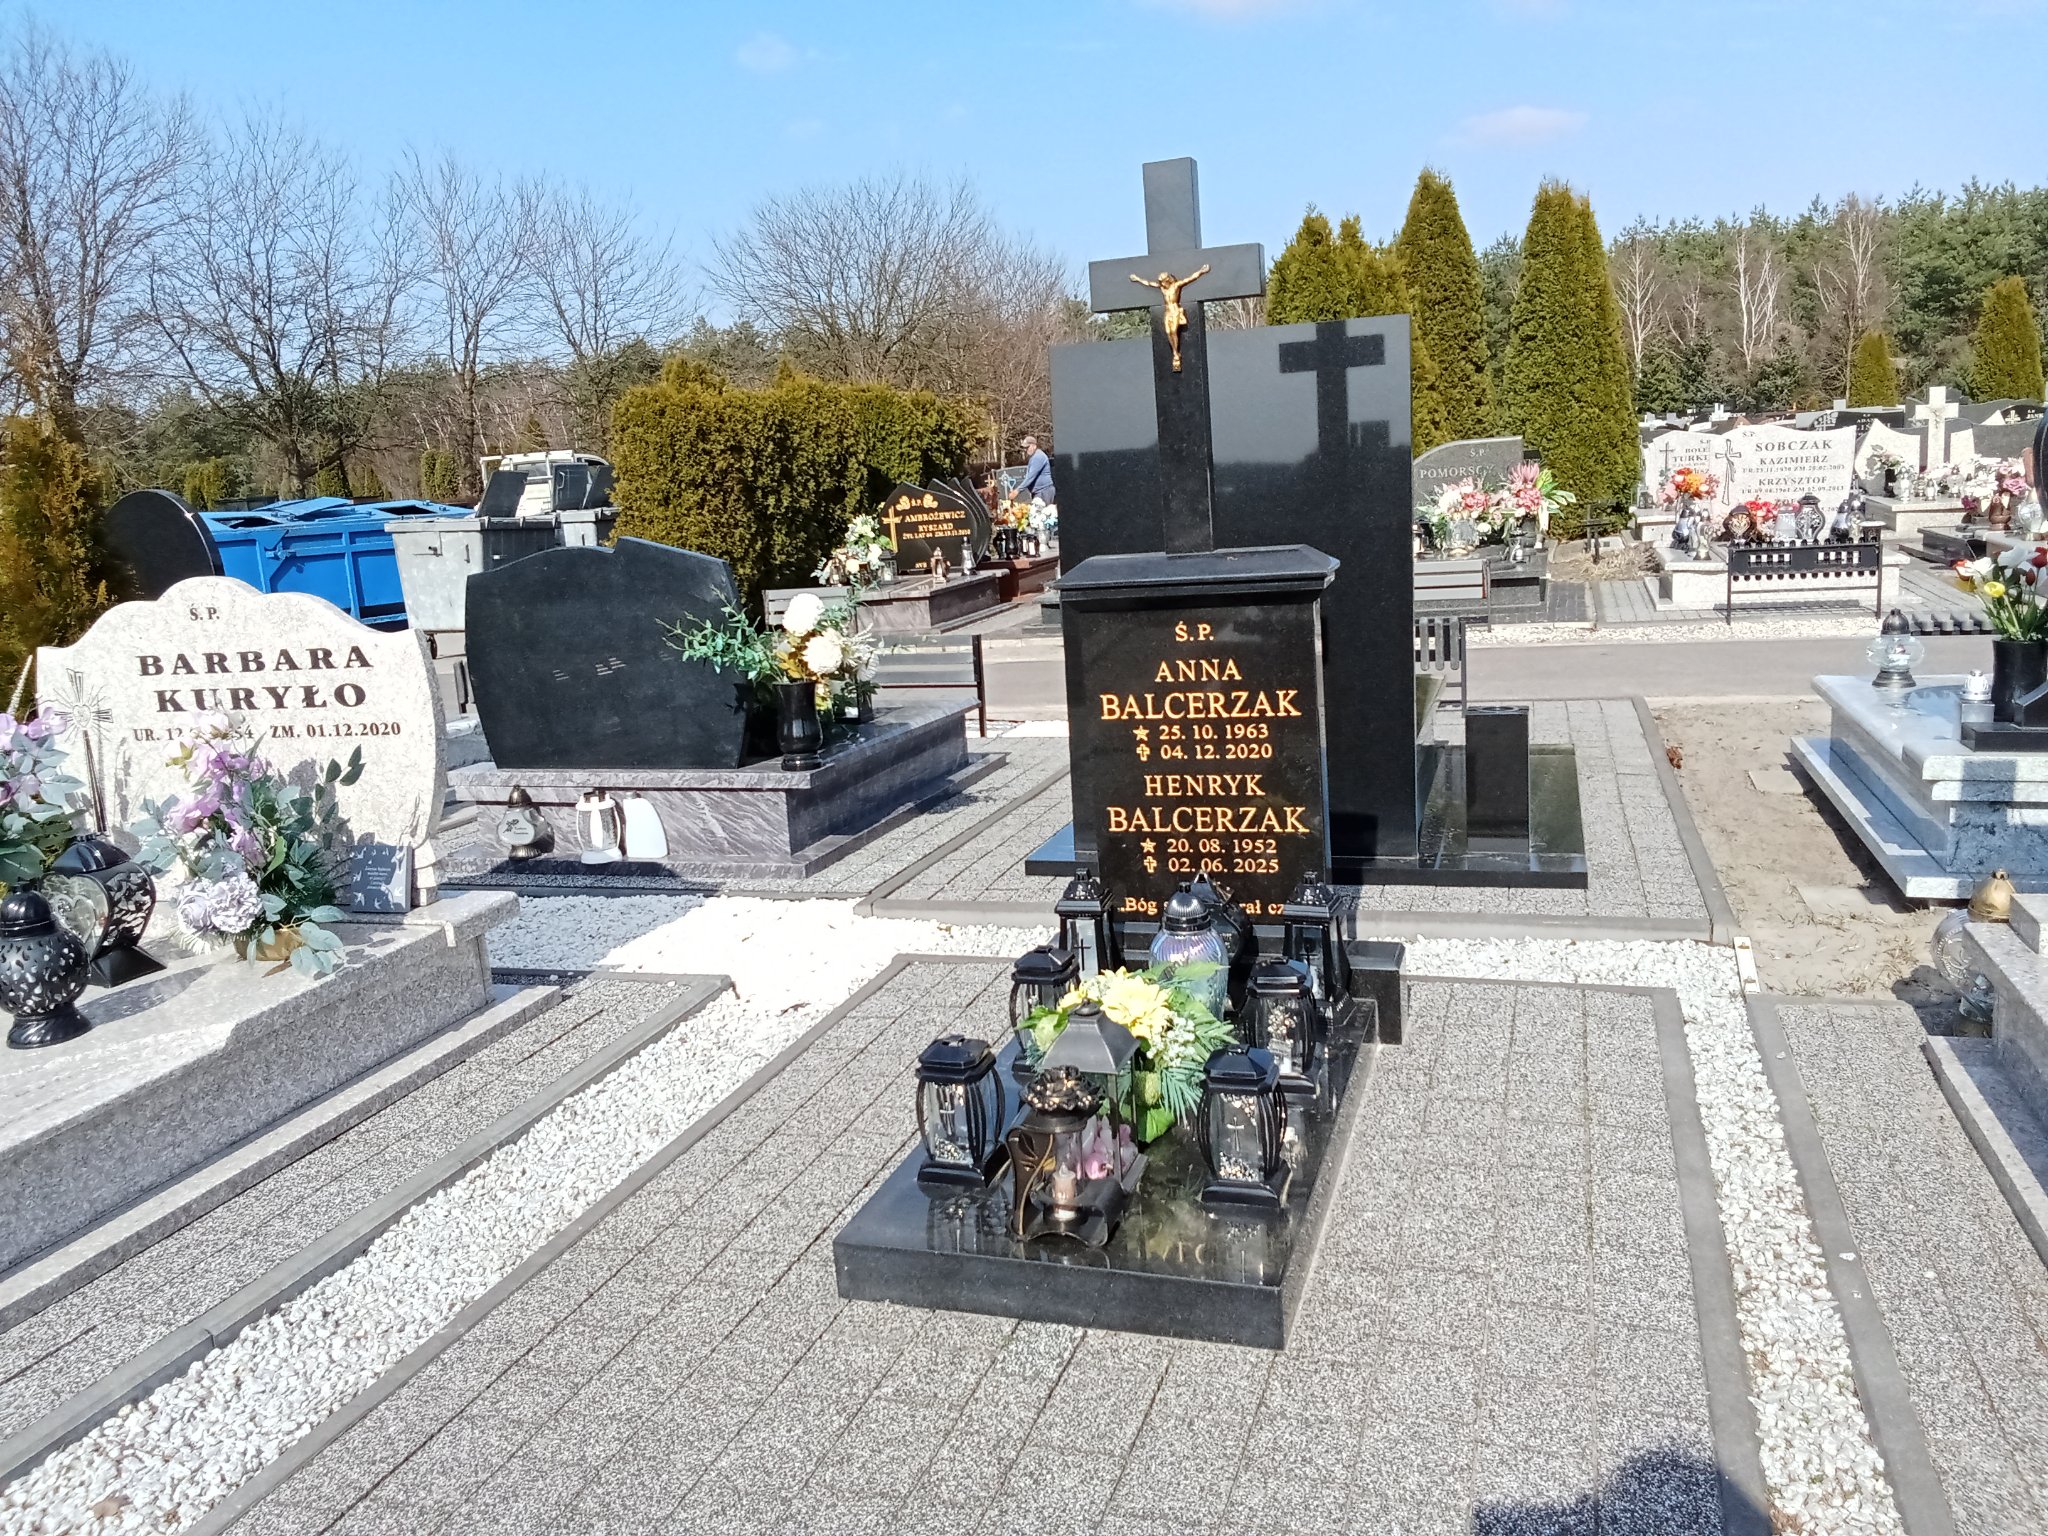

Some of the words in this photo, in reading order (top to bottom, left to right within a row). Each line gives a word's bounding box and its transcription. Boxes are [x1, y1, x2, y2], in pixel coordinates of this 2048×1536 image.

[1755, 439, 1833, 452] SOBCZAK
[1760, 455, 1828, 466] KAZIMIERZ
[1758, 476, 1828, 487] KRZYSZTOF
[904, 511, 966, 522] AMBROŻEWICZ
[918, 523, 953, 531] RYSZARD
[136, 645, 374, 676] BARBARA
[1155, 658, 1242, 683] ANNA
[154, 683, 367, 713] KURYŁO
[1100, 689, 1302, 720] BALCERZAK
[133, 727, 161, 741] UR.
[270, 724, 301, 739] ZM.
[306, 721, 402, 738] 01.12.2020
[1225, 723, 1269, 739] 1963
[1225, 743, 1273, 759] 2020
[1144, 774, 1266, 797] HENRYK
[1106, 805, 1310, 834] BALCERZAK
[1232, 838, 1277, 854] 1952
[1233, 858, 1279, 873] 2025
